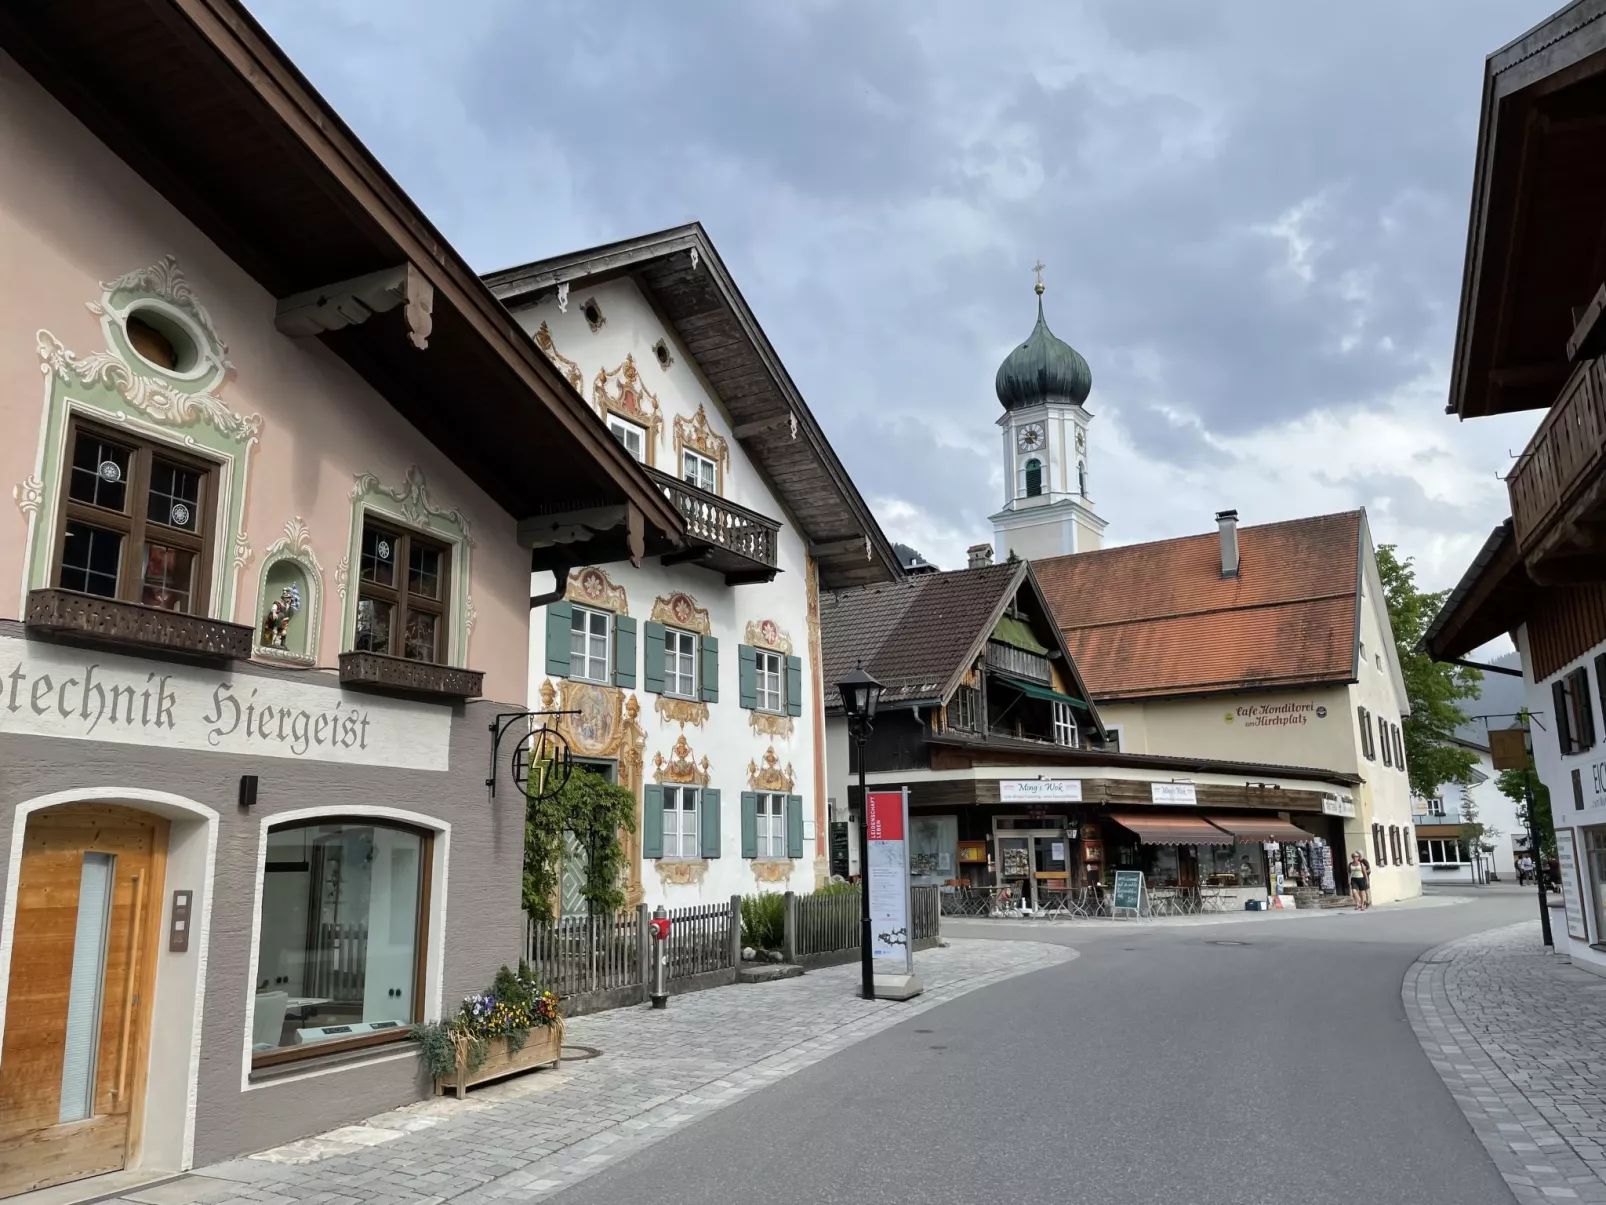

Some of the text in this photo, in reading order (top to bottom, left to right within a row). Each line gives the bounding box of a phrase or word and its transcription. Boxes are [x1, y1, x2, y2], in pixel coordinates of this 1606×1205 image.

[0, 661, 371, 756] technik Hiergeist
[1259, 701, 1314, 715] Konditorei
[1255, 713, 1307, 727] Kirchplatz
[1045, 782, 1064, 793] Wok
